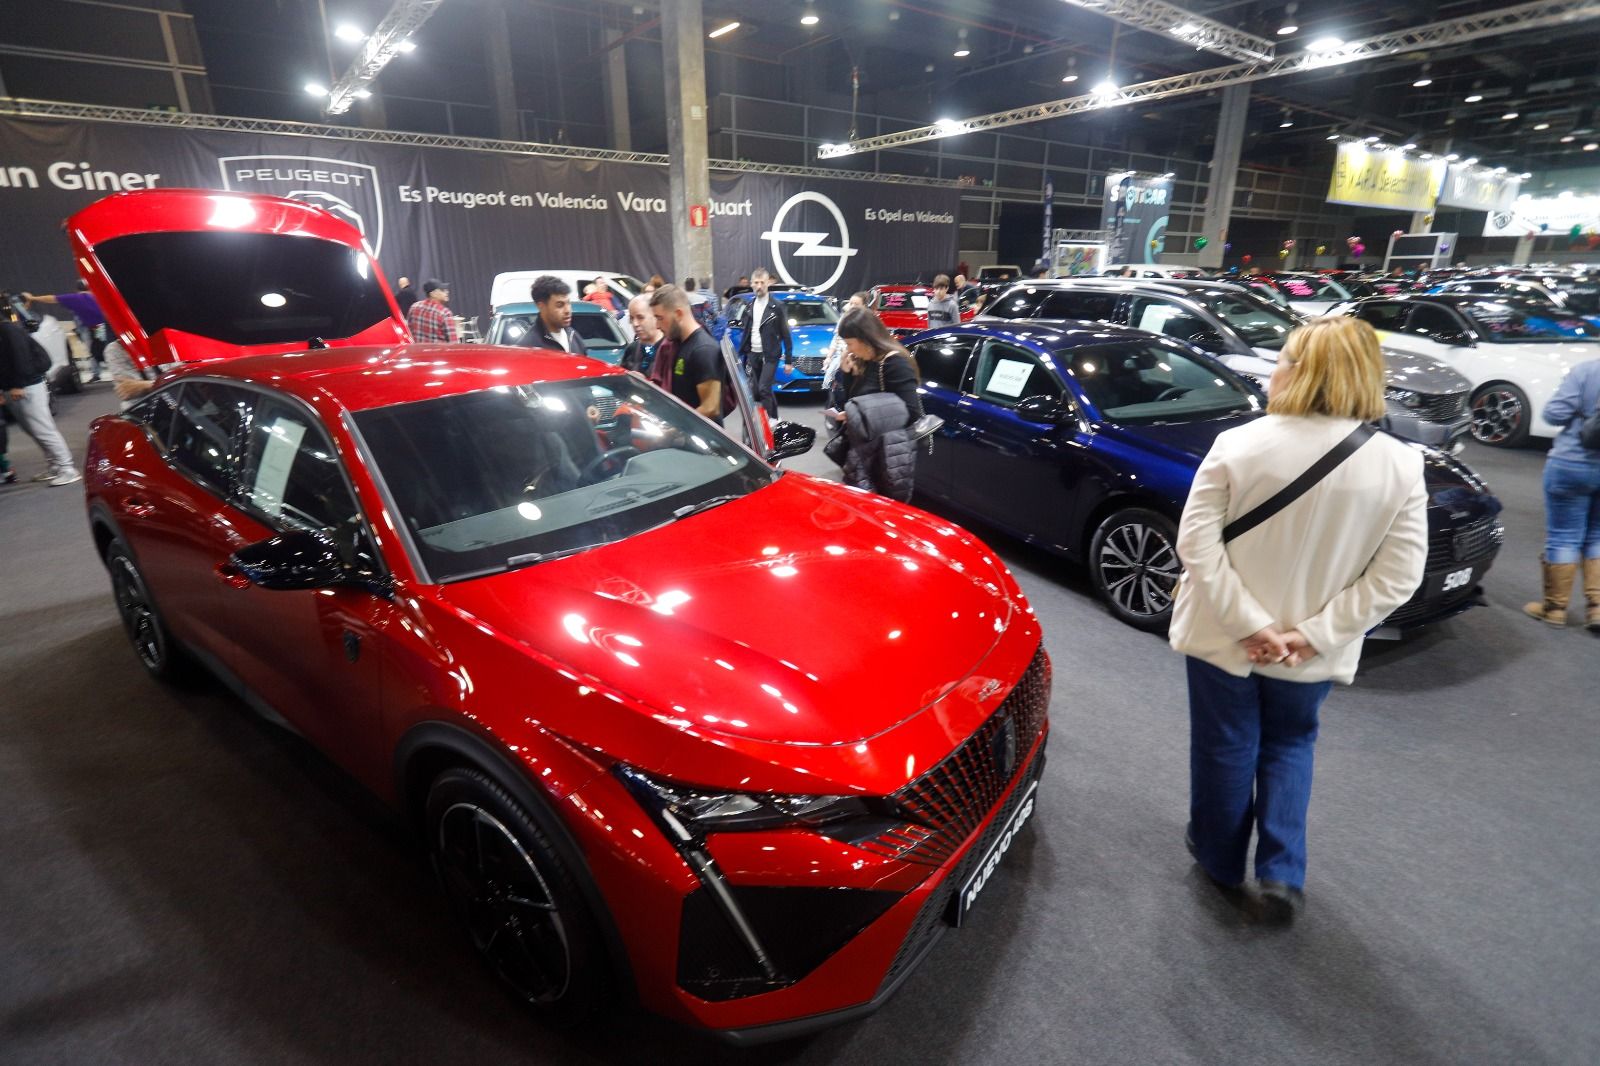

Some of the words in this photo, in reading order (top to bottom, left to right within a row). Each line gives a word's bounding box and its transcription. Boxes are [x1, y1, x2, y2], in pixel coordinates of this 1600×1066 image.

[47, 161, 160, 191] Giner
[235, 168, 365, 187] PEUGEOT
[398, 185, 423, 202] Es
[425, 186, 506, 208] Peugeot
[510, 194, 533, 207] en
[617, 191, 667, 213] Vara
[864, 203, 877, 221] Es
[878, 203, 902, 224] Opel
[902, 212, 915, 222] en
[966, 831, 1012, 911] NUEVO
